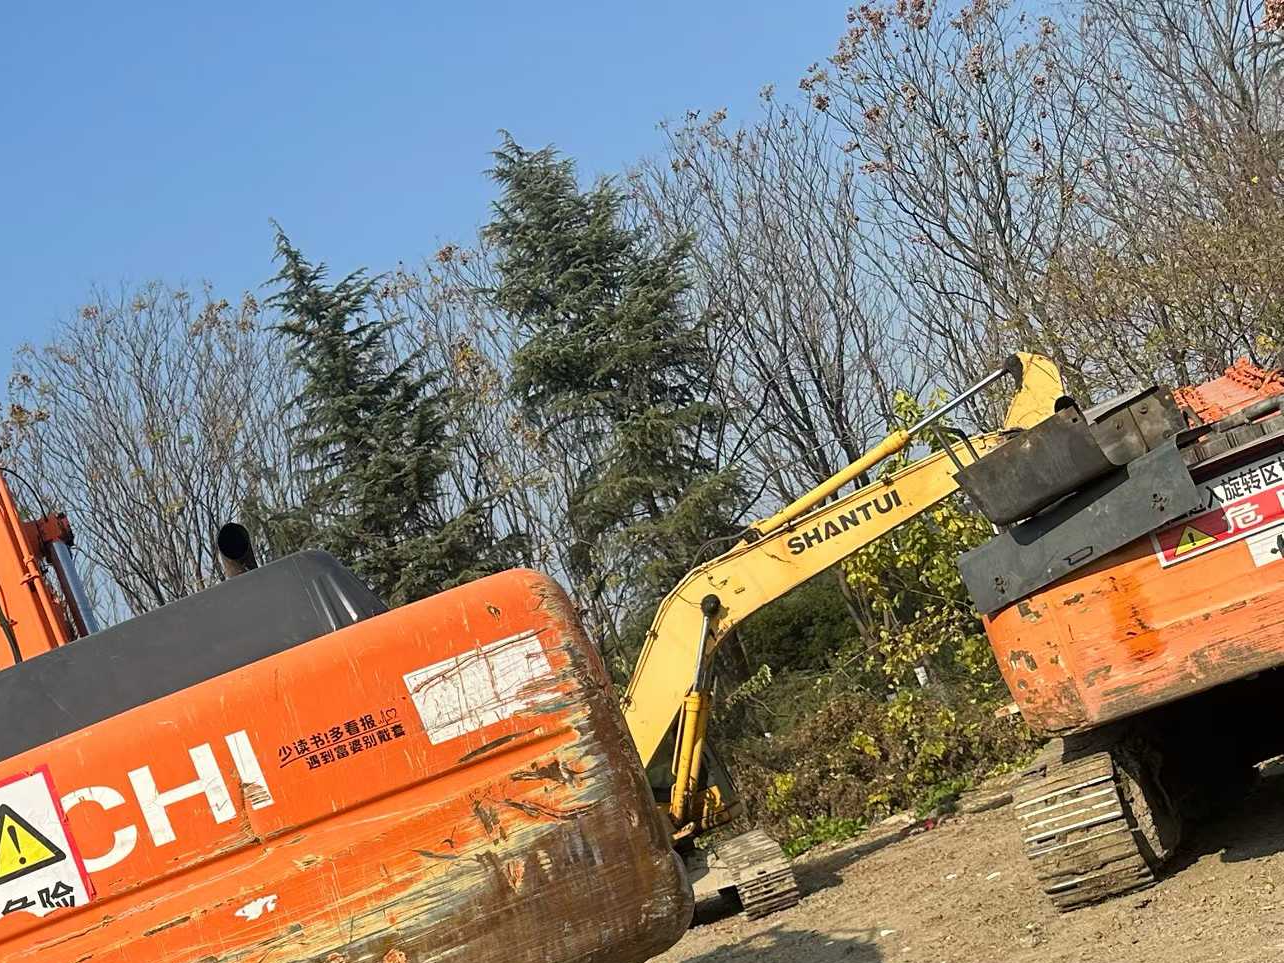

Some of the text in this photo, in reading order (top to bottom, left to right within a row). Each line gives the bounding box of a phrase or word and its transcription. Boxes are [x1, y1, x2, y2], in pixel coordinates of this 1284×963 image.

[1189, 456, 1284, 514] 入旋转区
[787, 489, 902, 555] SHANTUI
[278, 714, 377, 762] 少读书!多看报
[306, 723, 406, 770] 遇到富婆别戴套
[61, 730, 275, 873] CHI
